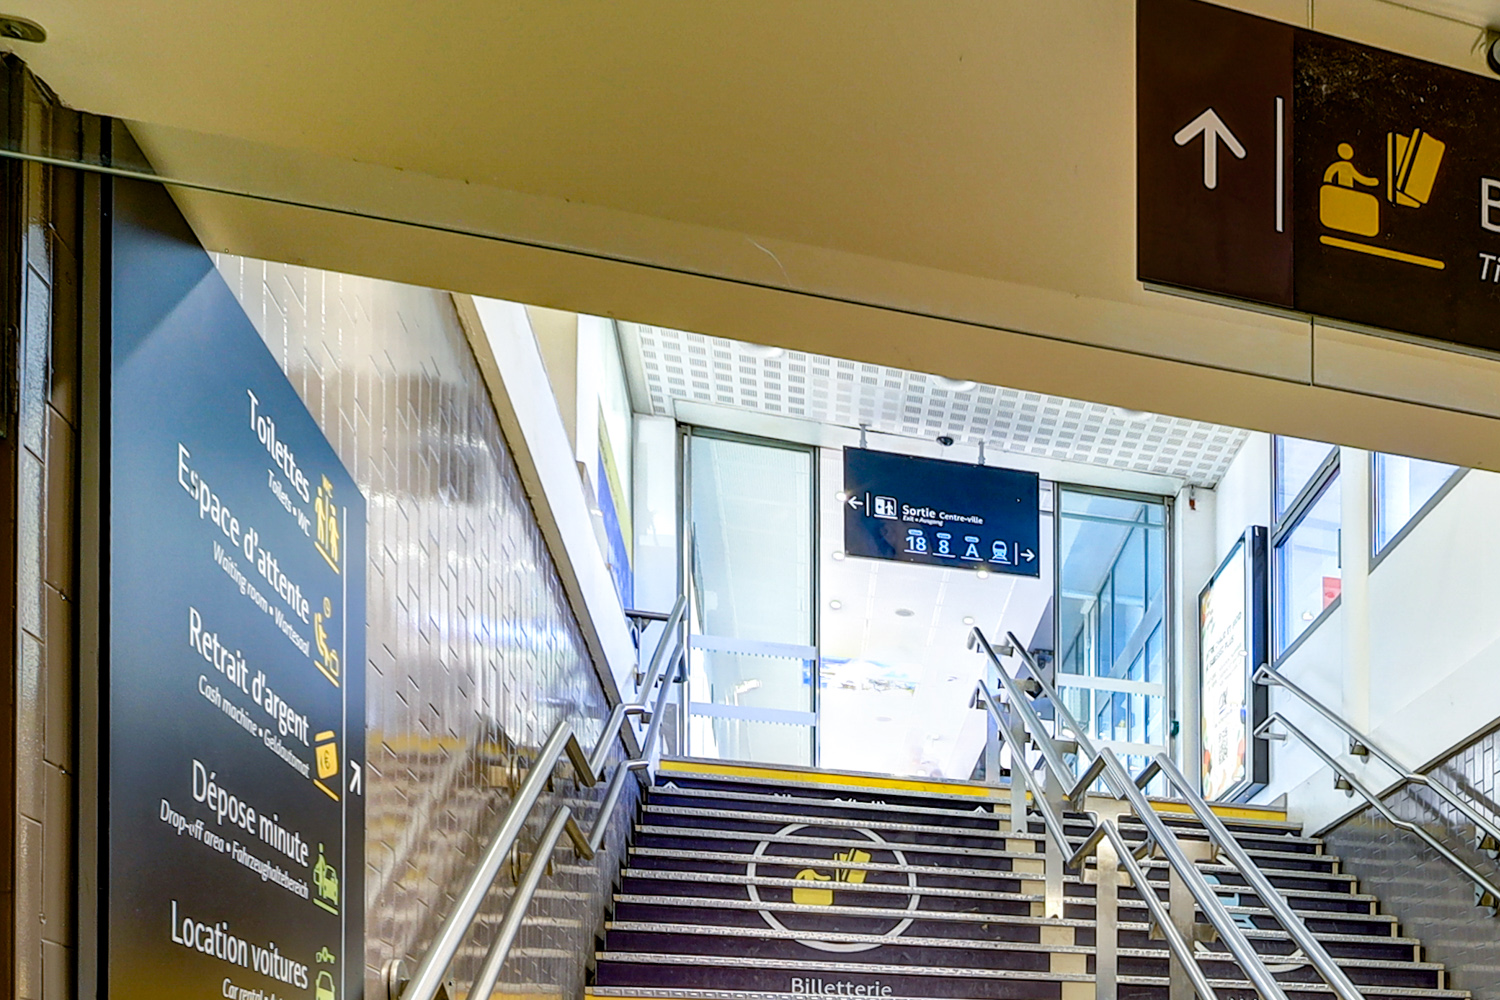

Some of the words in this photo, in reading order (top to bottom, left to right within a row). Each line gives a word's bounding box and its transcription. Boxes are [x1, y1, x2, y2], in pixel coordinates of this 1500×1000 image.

[247, 389, 310, 503] Toilettes
[178, 442, 240, 547] Espace
[243, 527, 310, 625] d'attente
[268, 468, 292, 513] Toilets
[298, 508, 311, 537] WC
[902, 504, 936, 519] Sortie
[939, 511, 984, 525] Centre-ville
[905, 536, 927, 551] 18
[938, 540, 950, 554] 8
[965, 543, 979, 558] A
[213, 540, 247, 595] Waiting
[246, 582, 268, 613] room
[274, 606, 310, 657] Wartesaal
[190, 606, 249, 695] Retrait
[252, 670, 310, 747] d'argent
[198, 674, 221, 708] Cash
[222, 698, 257, 737] machine
[263, 729, 310, 779] Geldautomat
[160, 799, 205, 841] Drop-off
[203, 830, 225, 853] area
[193, 758, 257, 835] Dépose
[259, 814, 310, 868] minute
[172, 900, 249, 968] Location
[251, 941, 309, 990] voitures
[222, 978, 240, 1000] Car
[791, 977, 893, 997] Billetterie
